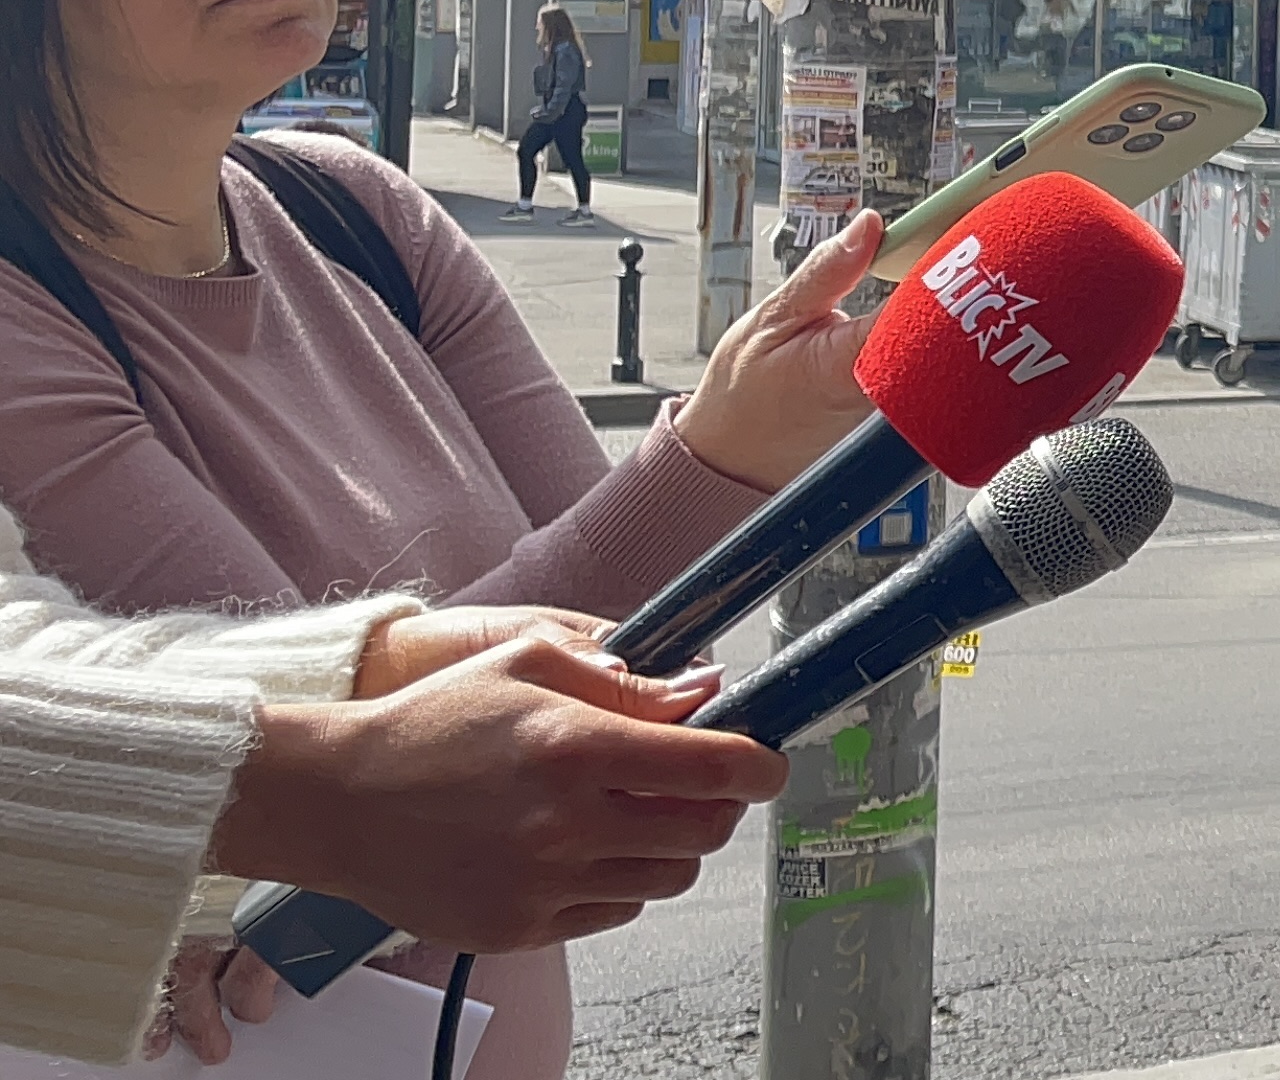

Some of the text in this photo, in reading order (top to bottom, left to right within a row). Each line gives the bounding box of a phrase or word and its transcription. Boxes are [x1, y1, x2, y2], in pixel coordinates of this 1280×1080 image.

[921, 234, 1070, 386] BLIC TV
[943, 644, 975, 664] 600
